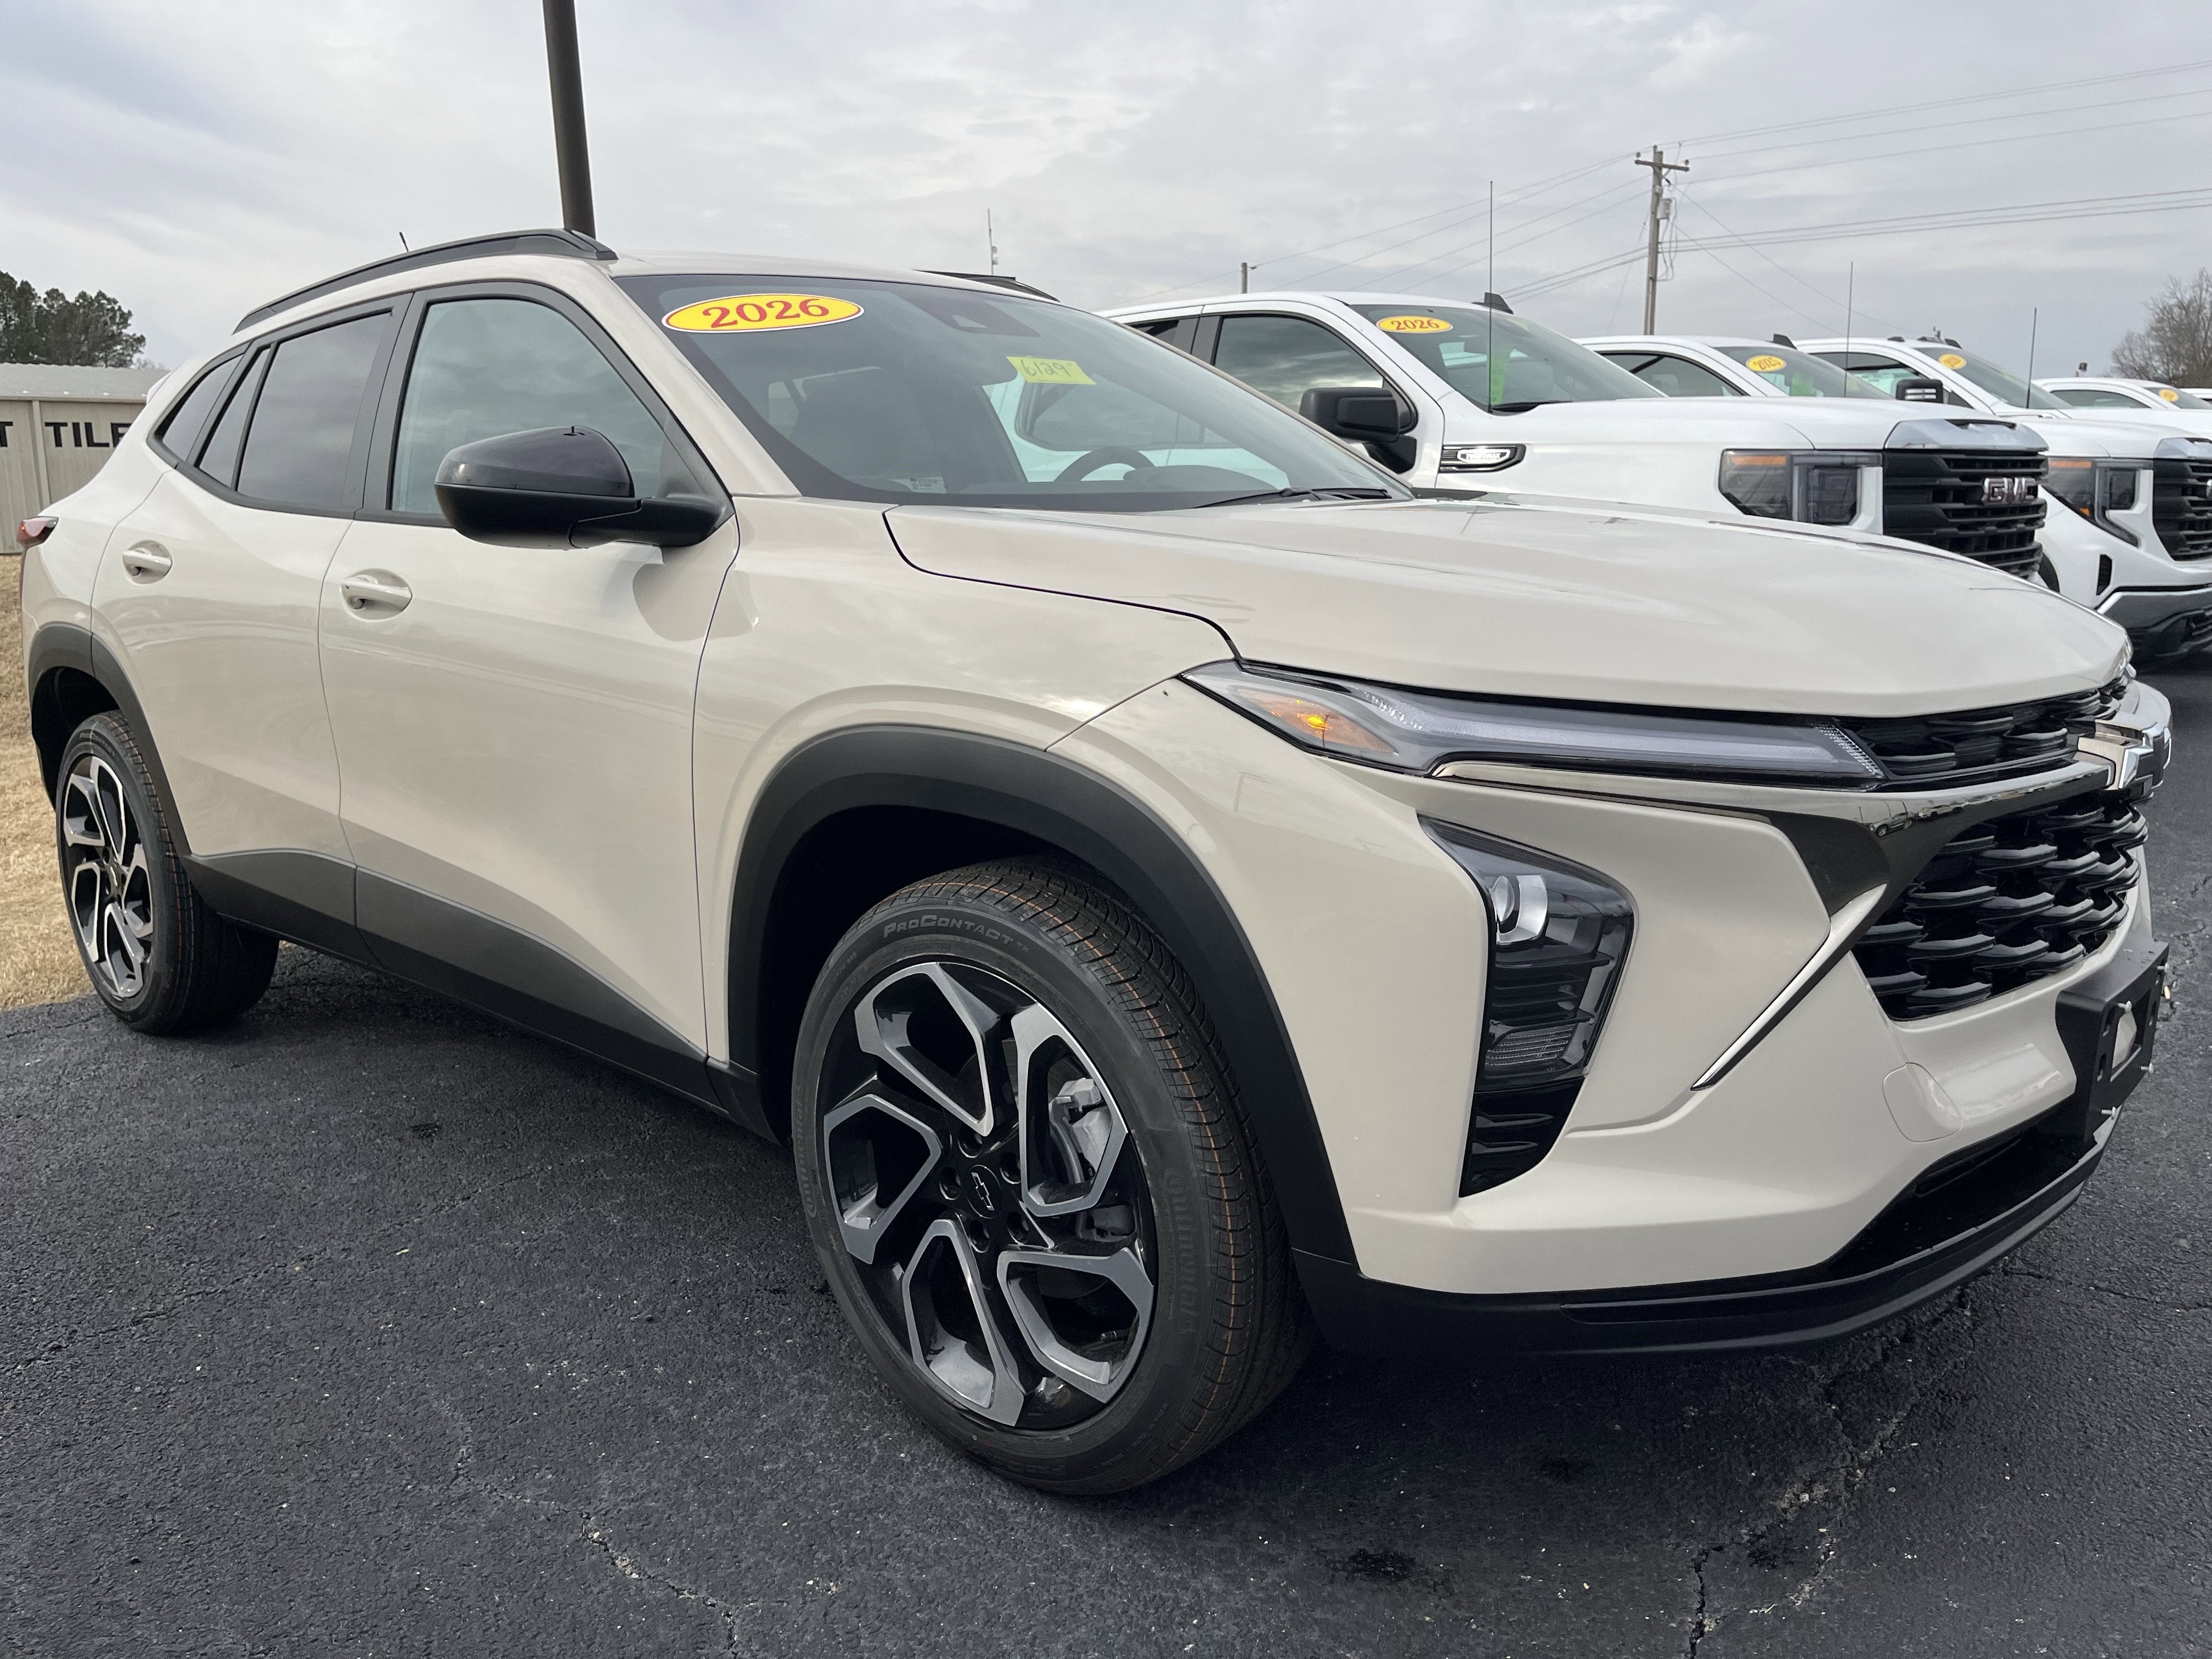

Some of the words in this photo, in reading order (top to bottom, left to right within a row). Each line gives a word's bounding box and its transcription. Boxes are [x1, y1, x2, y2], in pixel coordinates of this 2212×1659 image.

[702, 298, 829, 328] 2026
[1391, 319, 1439, 330] 2026
[1021, 359, 1071, 377] 6129
